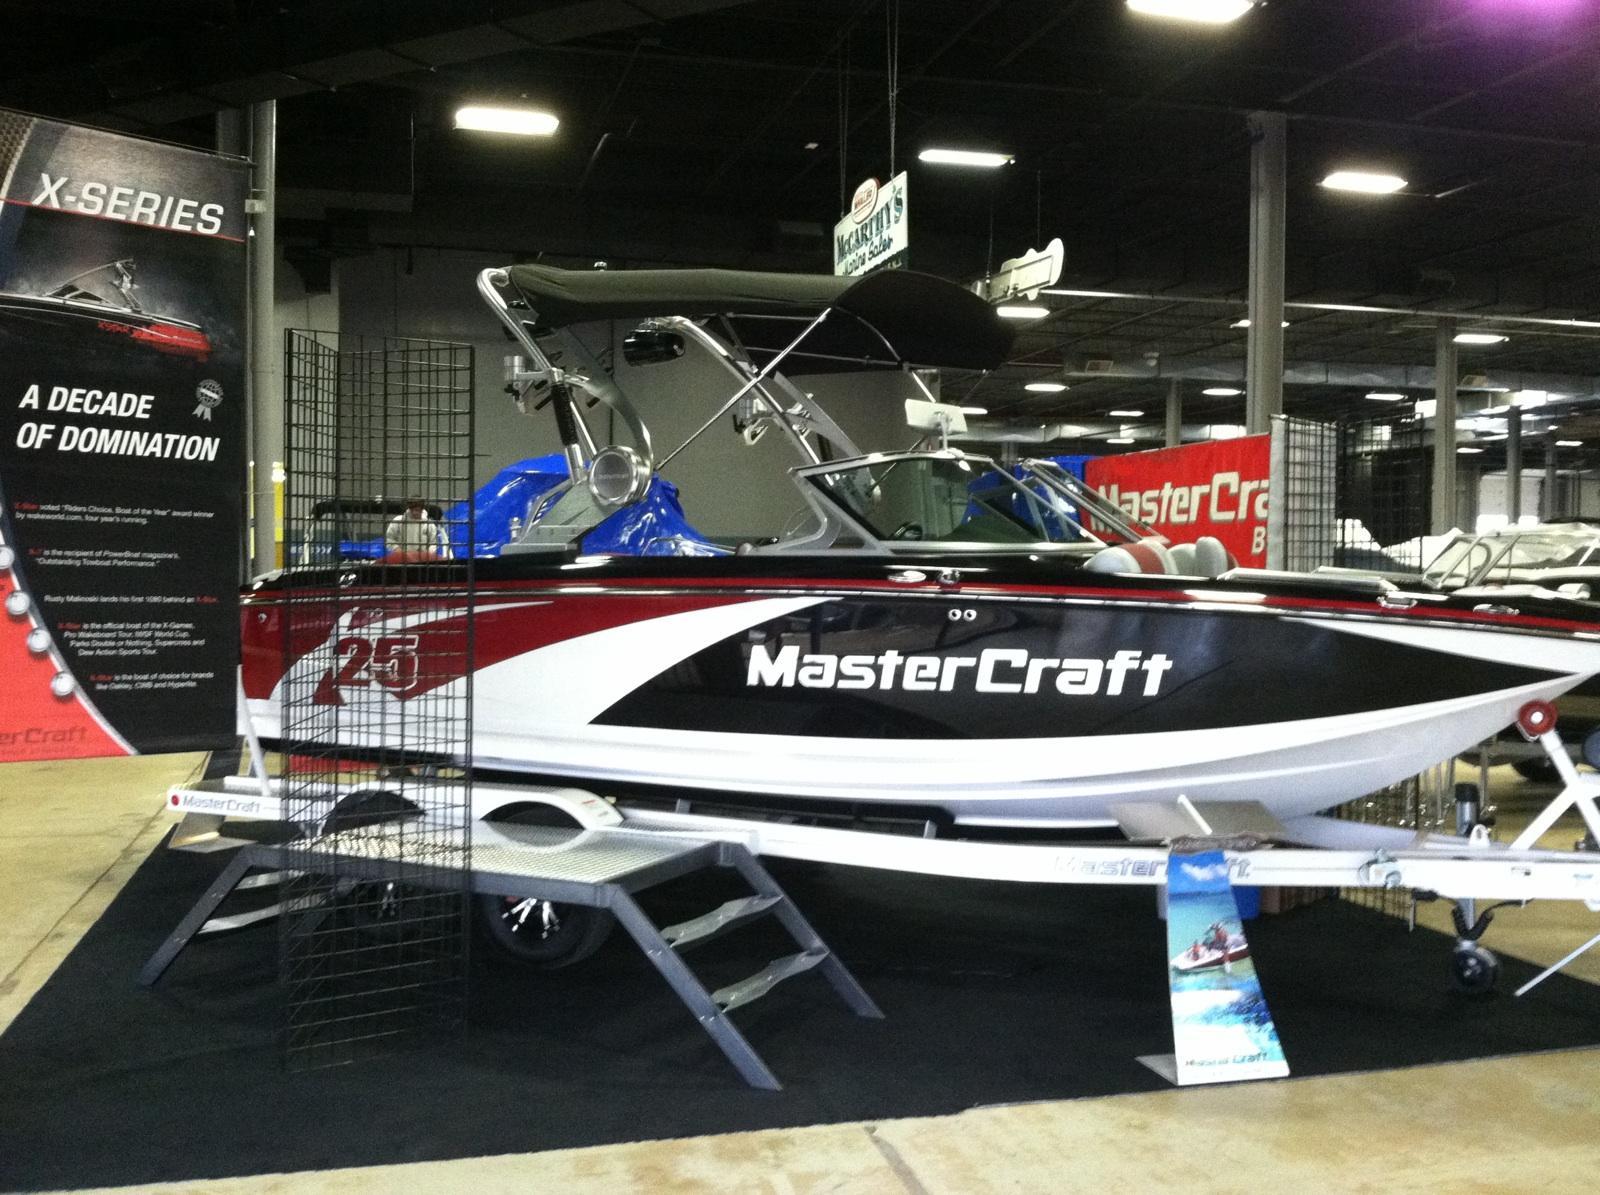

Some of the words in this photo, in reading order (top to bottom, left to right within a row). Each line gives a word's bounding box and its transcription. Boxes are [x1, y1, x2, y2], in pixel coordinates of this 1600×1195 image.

[31, 173, 224, 235] X-SERIES
[18, 384, 39, 409] A
[47, 386, 155, 419] DECADE
[16, 422, 56, 449] OF
[58, 425, 220, 461] DOMINATION
[746, 643, 1173, 697] MasterCraft
[183, 794, 260, 813] MasterCraft
